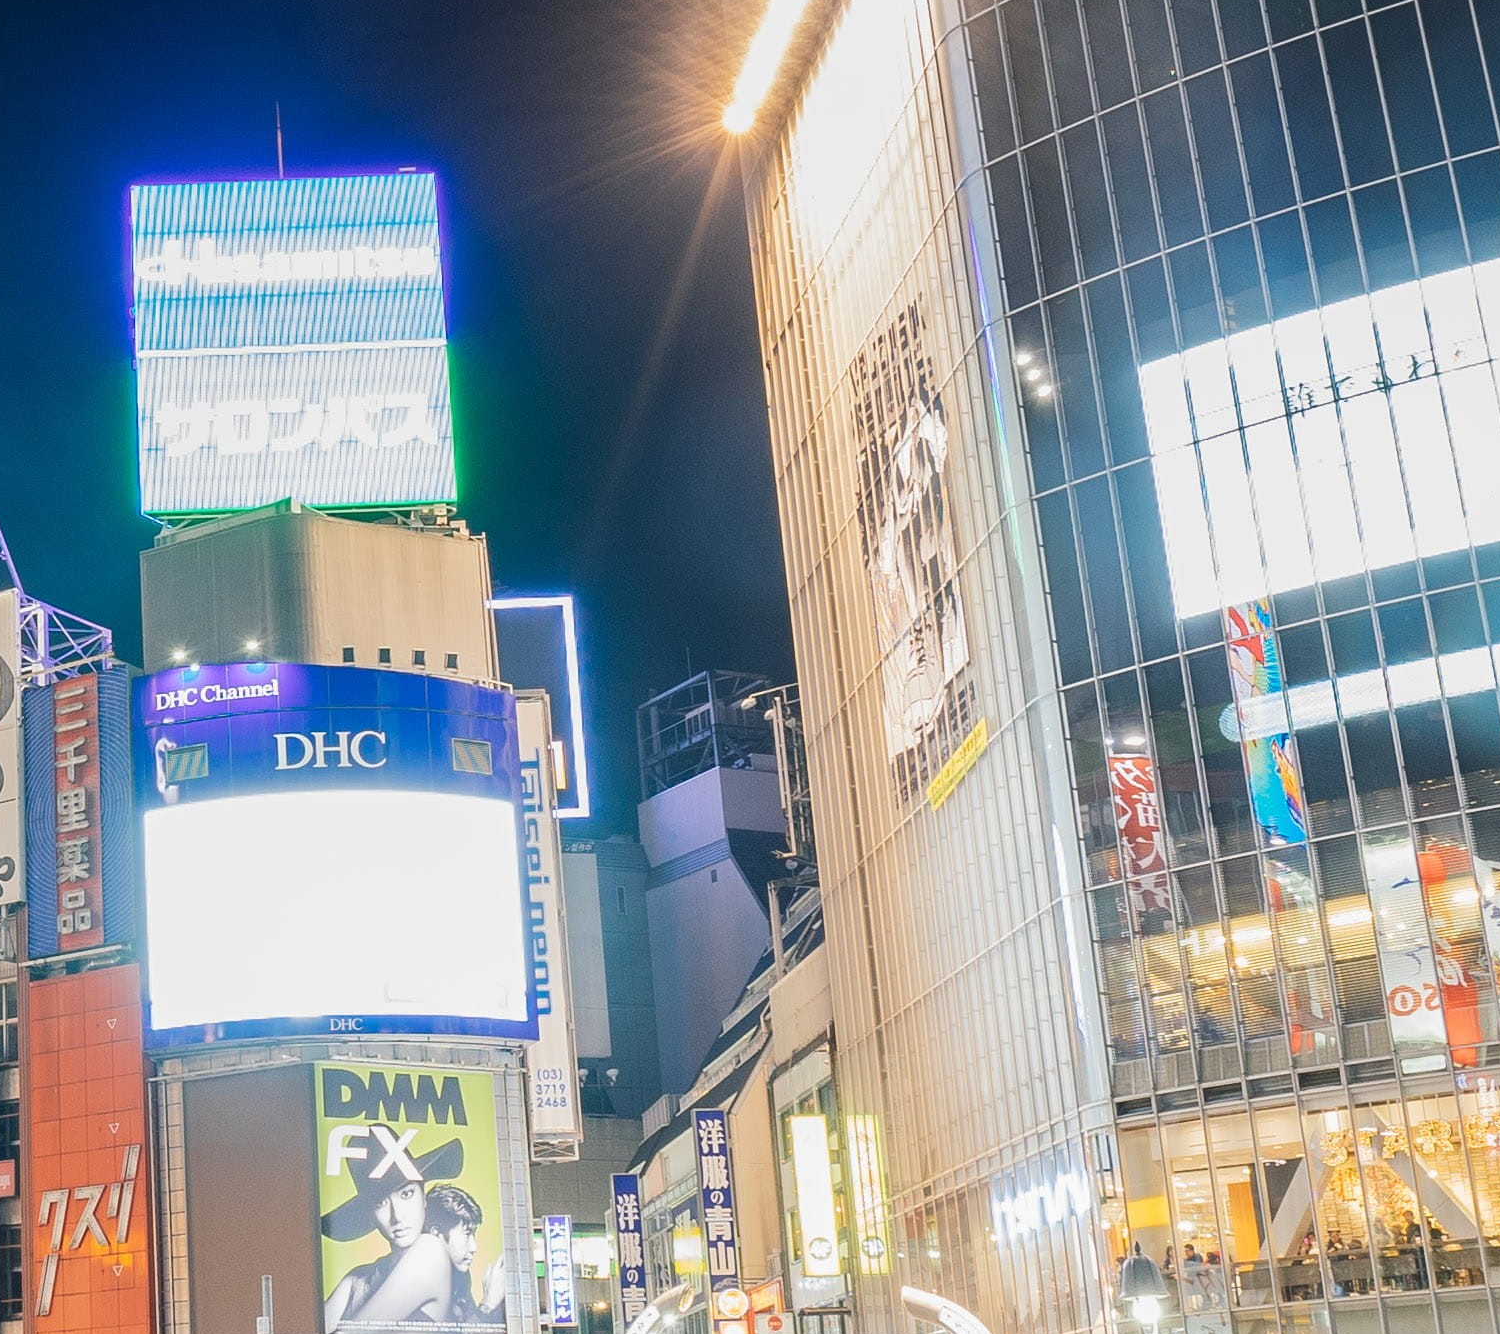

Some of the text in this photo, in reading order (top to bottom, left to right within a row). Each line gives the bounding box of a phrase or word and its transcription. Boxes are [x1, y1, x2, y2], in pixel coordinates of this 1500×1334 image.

[155, 394, 438, 457] サロンパス
[155, 679, 279, 711] DHC Channel
[274, 730, 388, 771] DHC
[53, 685, 92, 935] 三千里薬品
[329, 1017, 364, 1031] DHC
[323, 1068, 468, 1126] DMM
[535, 1083, 566, 1096] 3719
[536, 1068, 563, 1080] (03)
[537, 1096, 567, 1109] 2468
[326, 1125, 424, 1181] FX
[698, 1117, 736, 1277] 洋服の青山
[617, 1193, 648, 1322] 洋服の青
